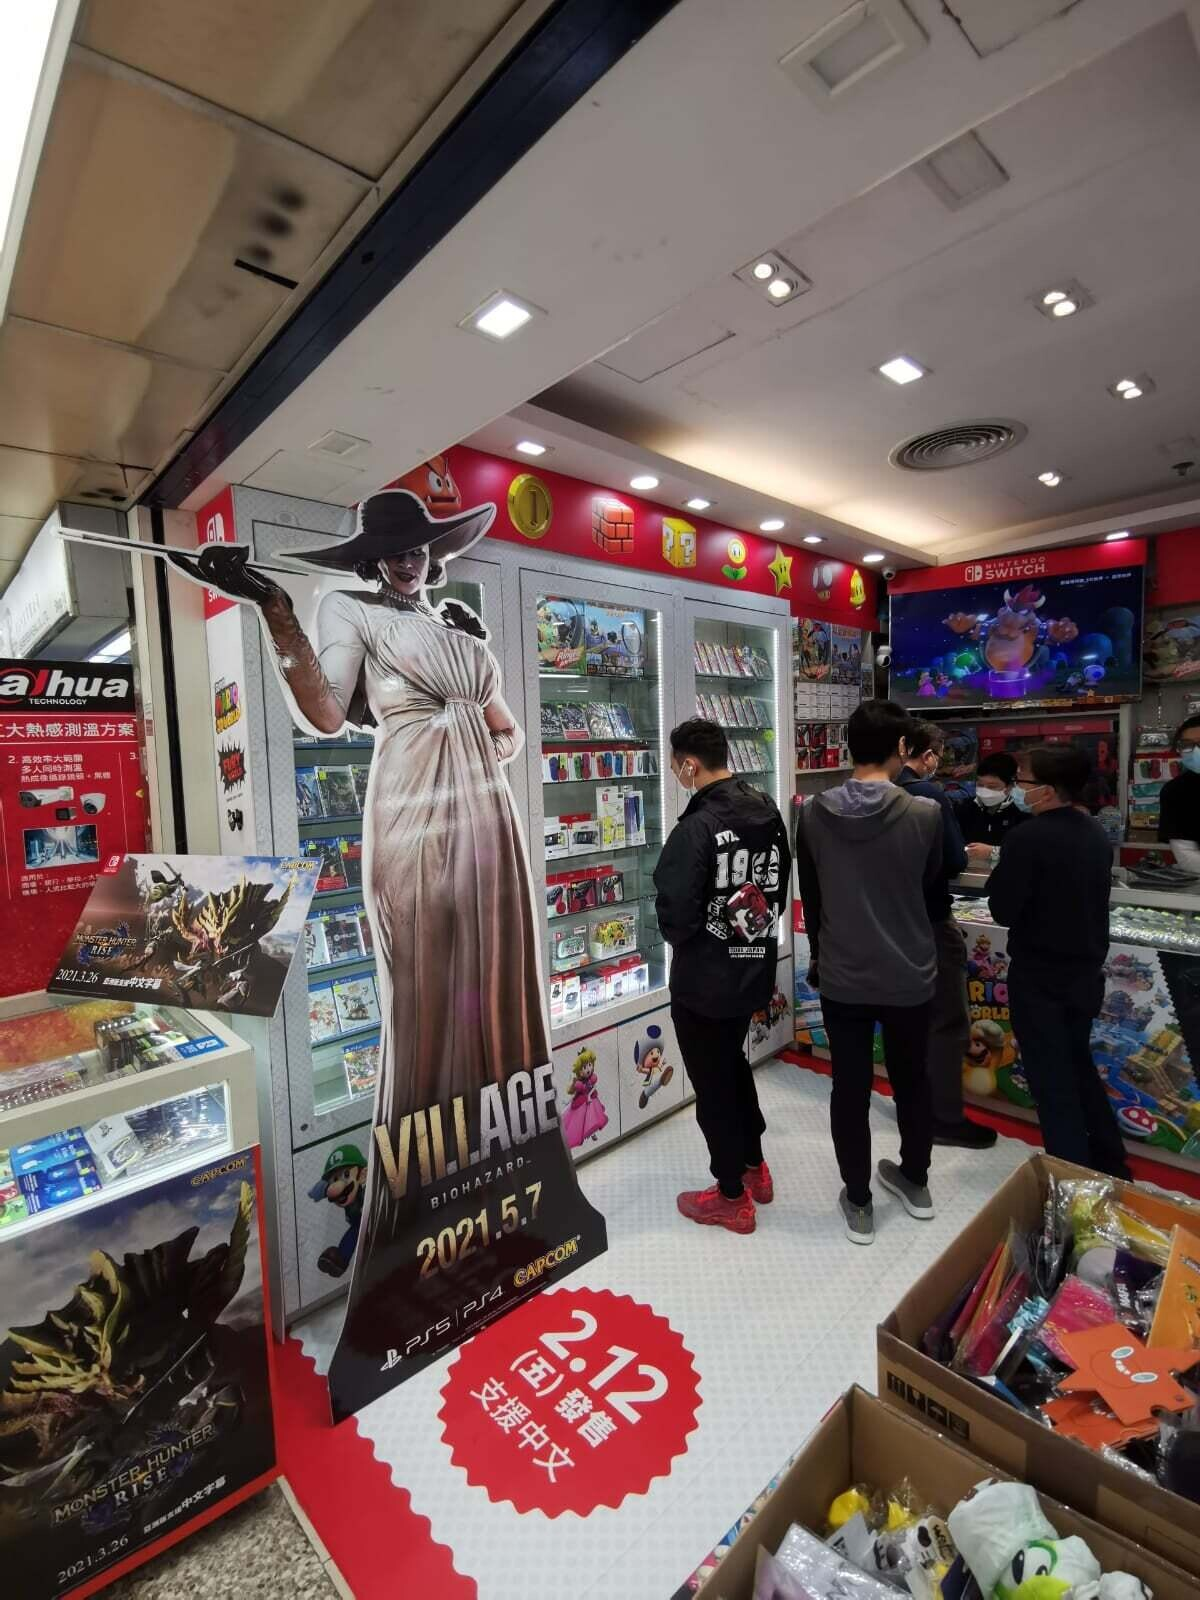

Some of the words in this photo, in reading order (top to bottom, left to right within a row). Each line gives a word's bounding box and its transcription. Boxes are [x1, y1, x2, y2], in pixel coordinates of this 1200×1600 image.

[985, 564, 1046, 580] SWITCH
[986, 556, 1046, 569] NINTENDO
[91, 945, 113, 955] RISE
[55, 968, 100, 983] 2021.3.26
[192, 1158, 247, 1187] CAPCOM
[430, 1156, 526, 1210] BIOHAZARD
[416, 1181, 542, 1280] 2021.5.7
[513, 1236, 579, 1287] CAPCOM
[405, 1316, 451, 1354] PS5
[463, 1285, 504, 1319] PS4
[538, 1309, 669, 1425] 2.12
[469, 1376, 575, 1483] 支援中文
[54, 1465, 140, 1523] MONSTER
[147, 1424, 213, 1471] HUNTER
[114, 1467, 169, 1507] RISE
[57, 1535, 129, 1584] 2021.3.26
